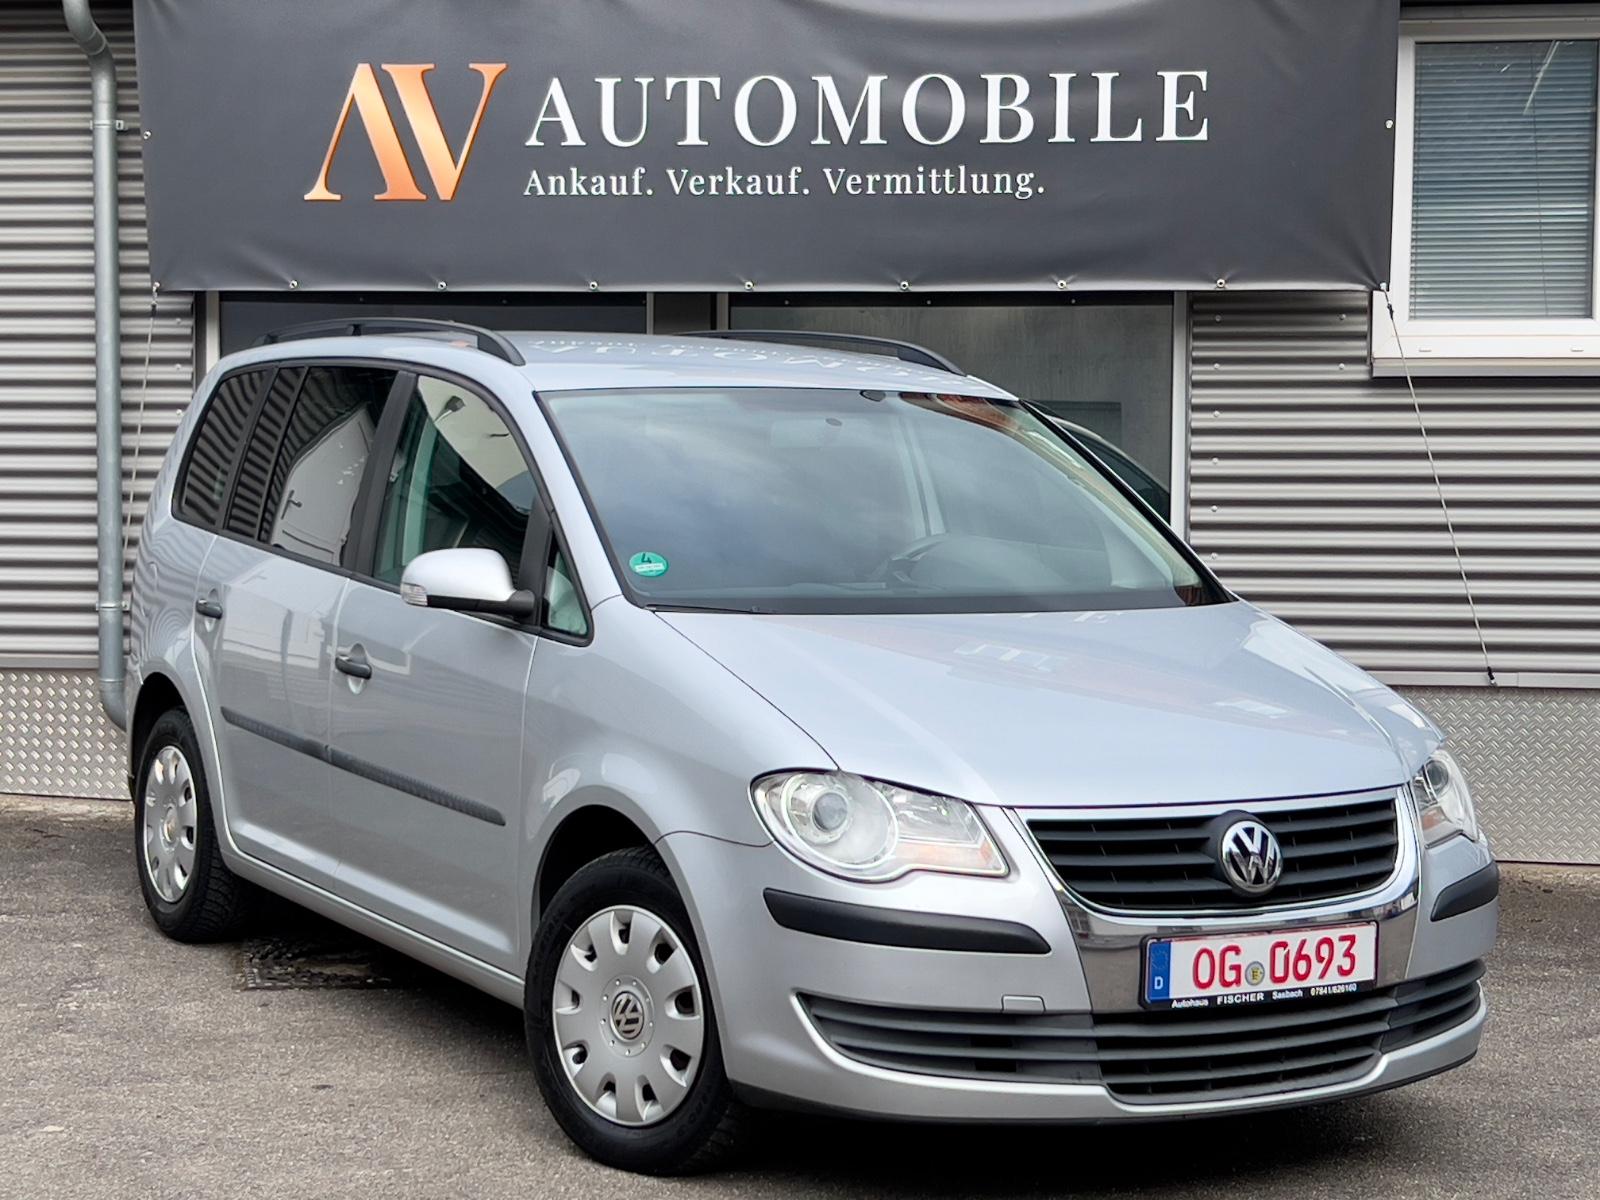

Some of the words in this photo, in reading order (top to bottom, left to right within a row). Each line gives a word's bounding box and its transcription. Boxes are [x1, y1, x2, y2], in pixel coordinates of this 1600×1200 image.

[304, 62, 508, 201] AV
[525, 70, 1209, 148] AUTOMOBILE
[523, 166, 653, 196] Ankauf.
[666, 166, 811, 195] Verkauf.
[823, 165, 1046, 200] Vermittlung.
[1154, 976, 1164, 990] D
[1192, 944, 1242, 990] OG
[1269, 934, 1356, 984] 0693
[1171, 998, 1209, 1009] Autohaus
[1217, 992, 1264, 1005] FISCHER
[1272, 989, 1303, 1000] Sasbach
